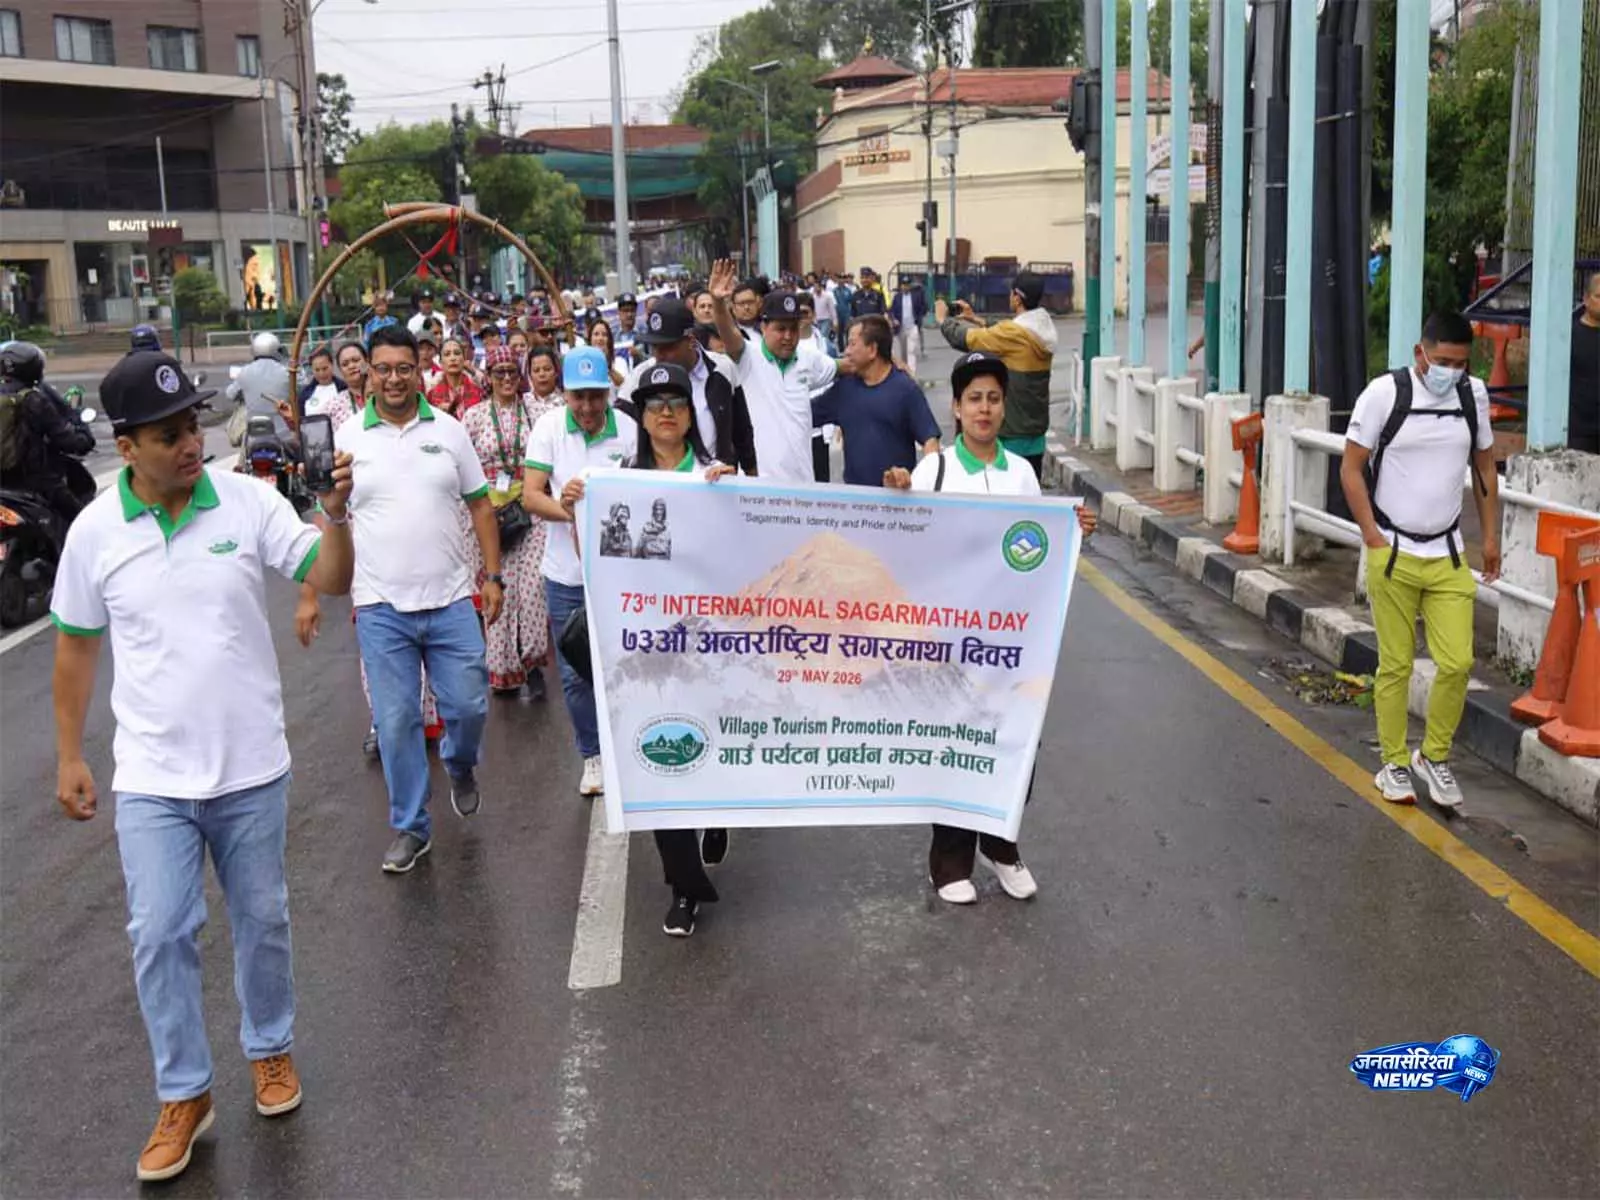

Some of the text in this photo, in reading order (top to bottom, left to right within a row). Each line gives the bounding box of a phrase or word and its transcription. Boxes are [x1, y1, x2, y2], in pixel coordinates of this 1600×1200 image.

[842, 519, 860, 529] and
[861, 518, 885, 530] Pride
[887, 520, 897, 531] of
[621, 592, 1029, 632] 73rd INTERNATIONAL SAGARMATHA DAY
[838, 634, 954, 663] सगरमाथा
[960, 636, 1023, 669] दिवस
[802, 670, 829, 683] MAY
[833, 671, 862, 685] 2026
[719, 716, 996, 746] Village Tourism Promotion Forum-Nepal
[719, 744, 756, 765] गाउँ
[761, 743, 819, 764] पर्यटन
[806, 775, 895, 792] (VITOF-Nepal)
